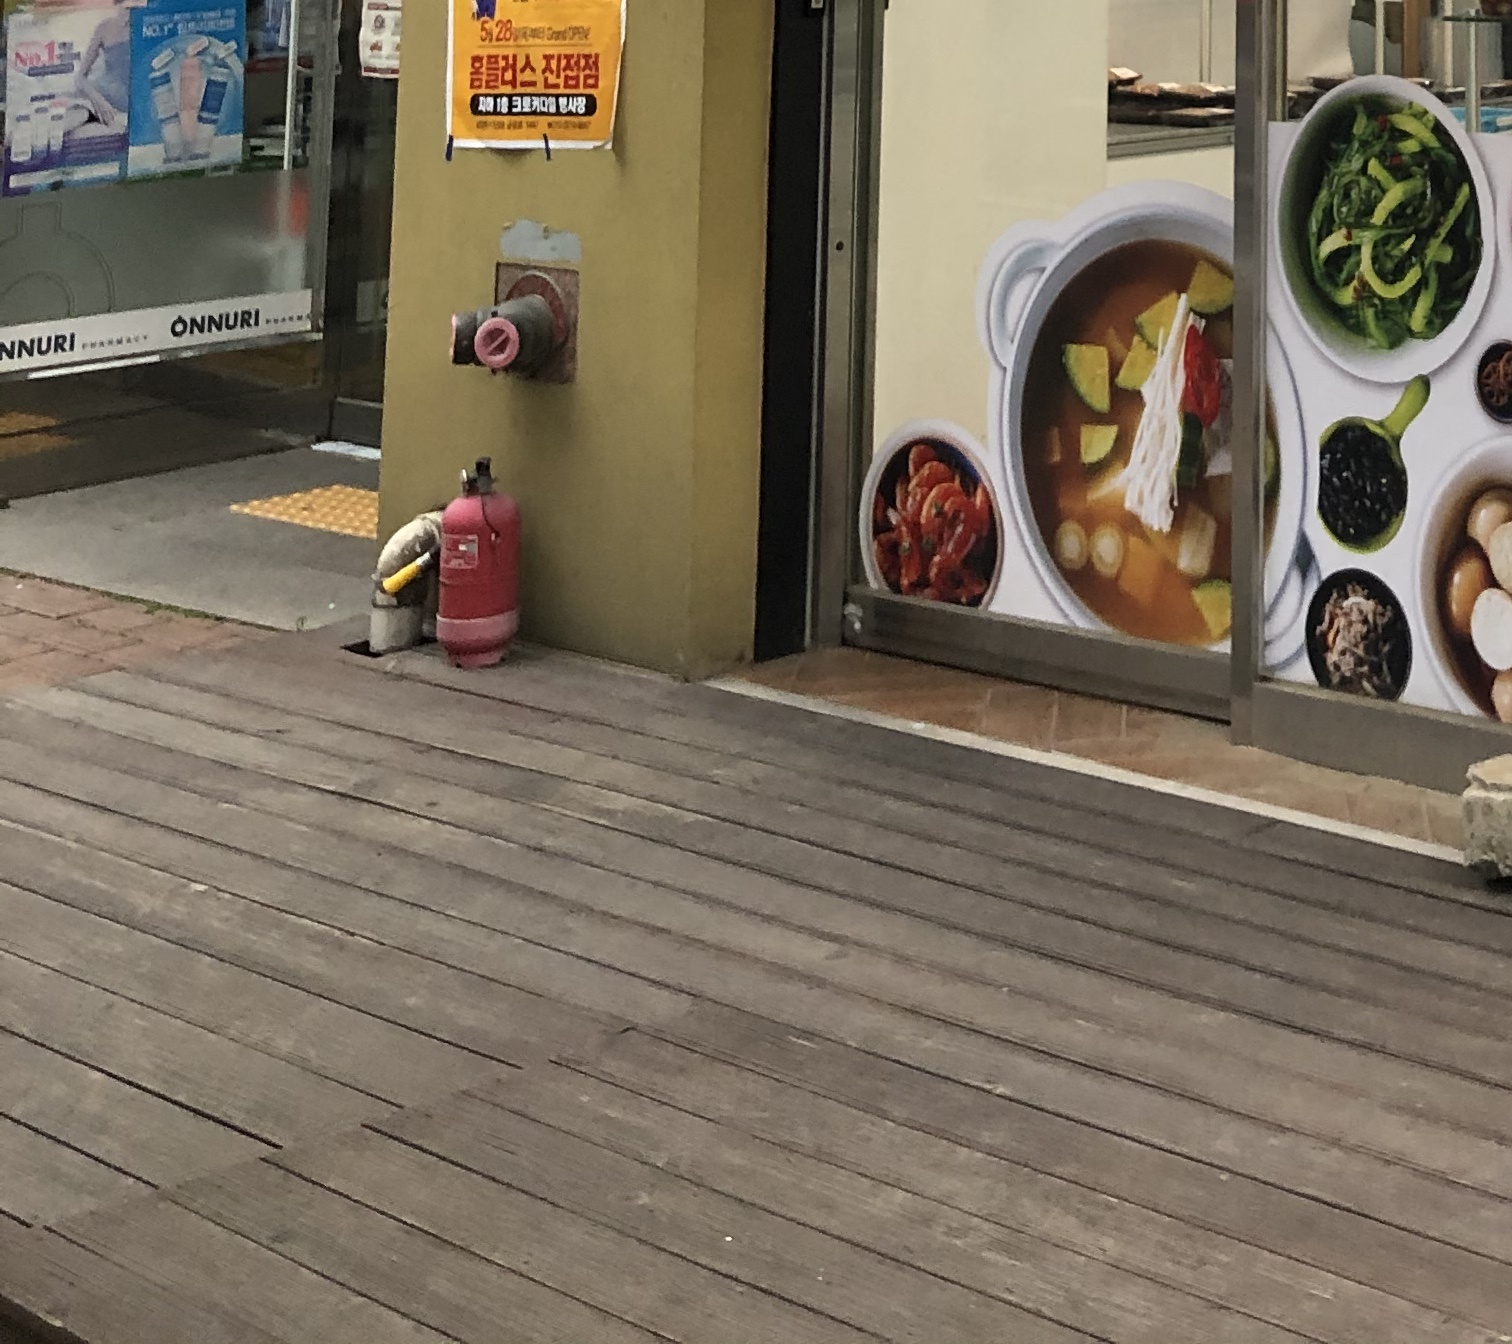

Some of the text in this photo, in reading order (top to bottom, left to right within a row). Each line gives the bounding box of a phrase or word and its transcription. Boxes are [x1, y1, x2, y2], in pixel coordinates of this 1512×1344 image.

[469, 52, 600, 90] 홈플러스 진접점
[511, 96, 557, 114] 크로커다일
[558, 96, 587, 114] 행사장
